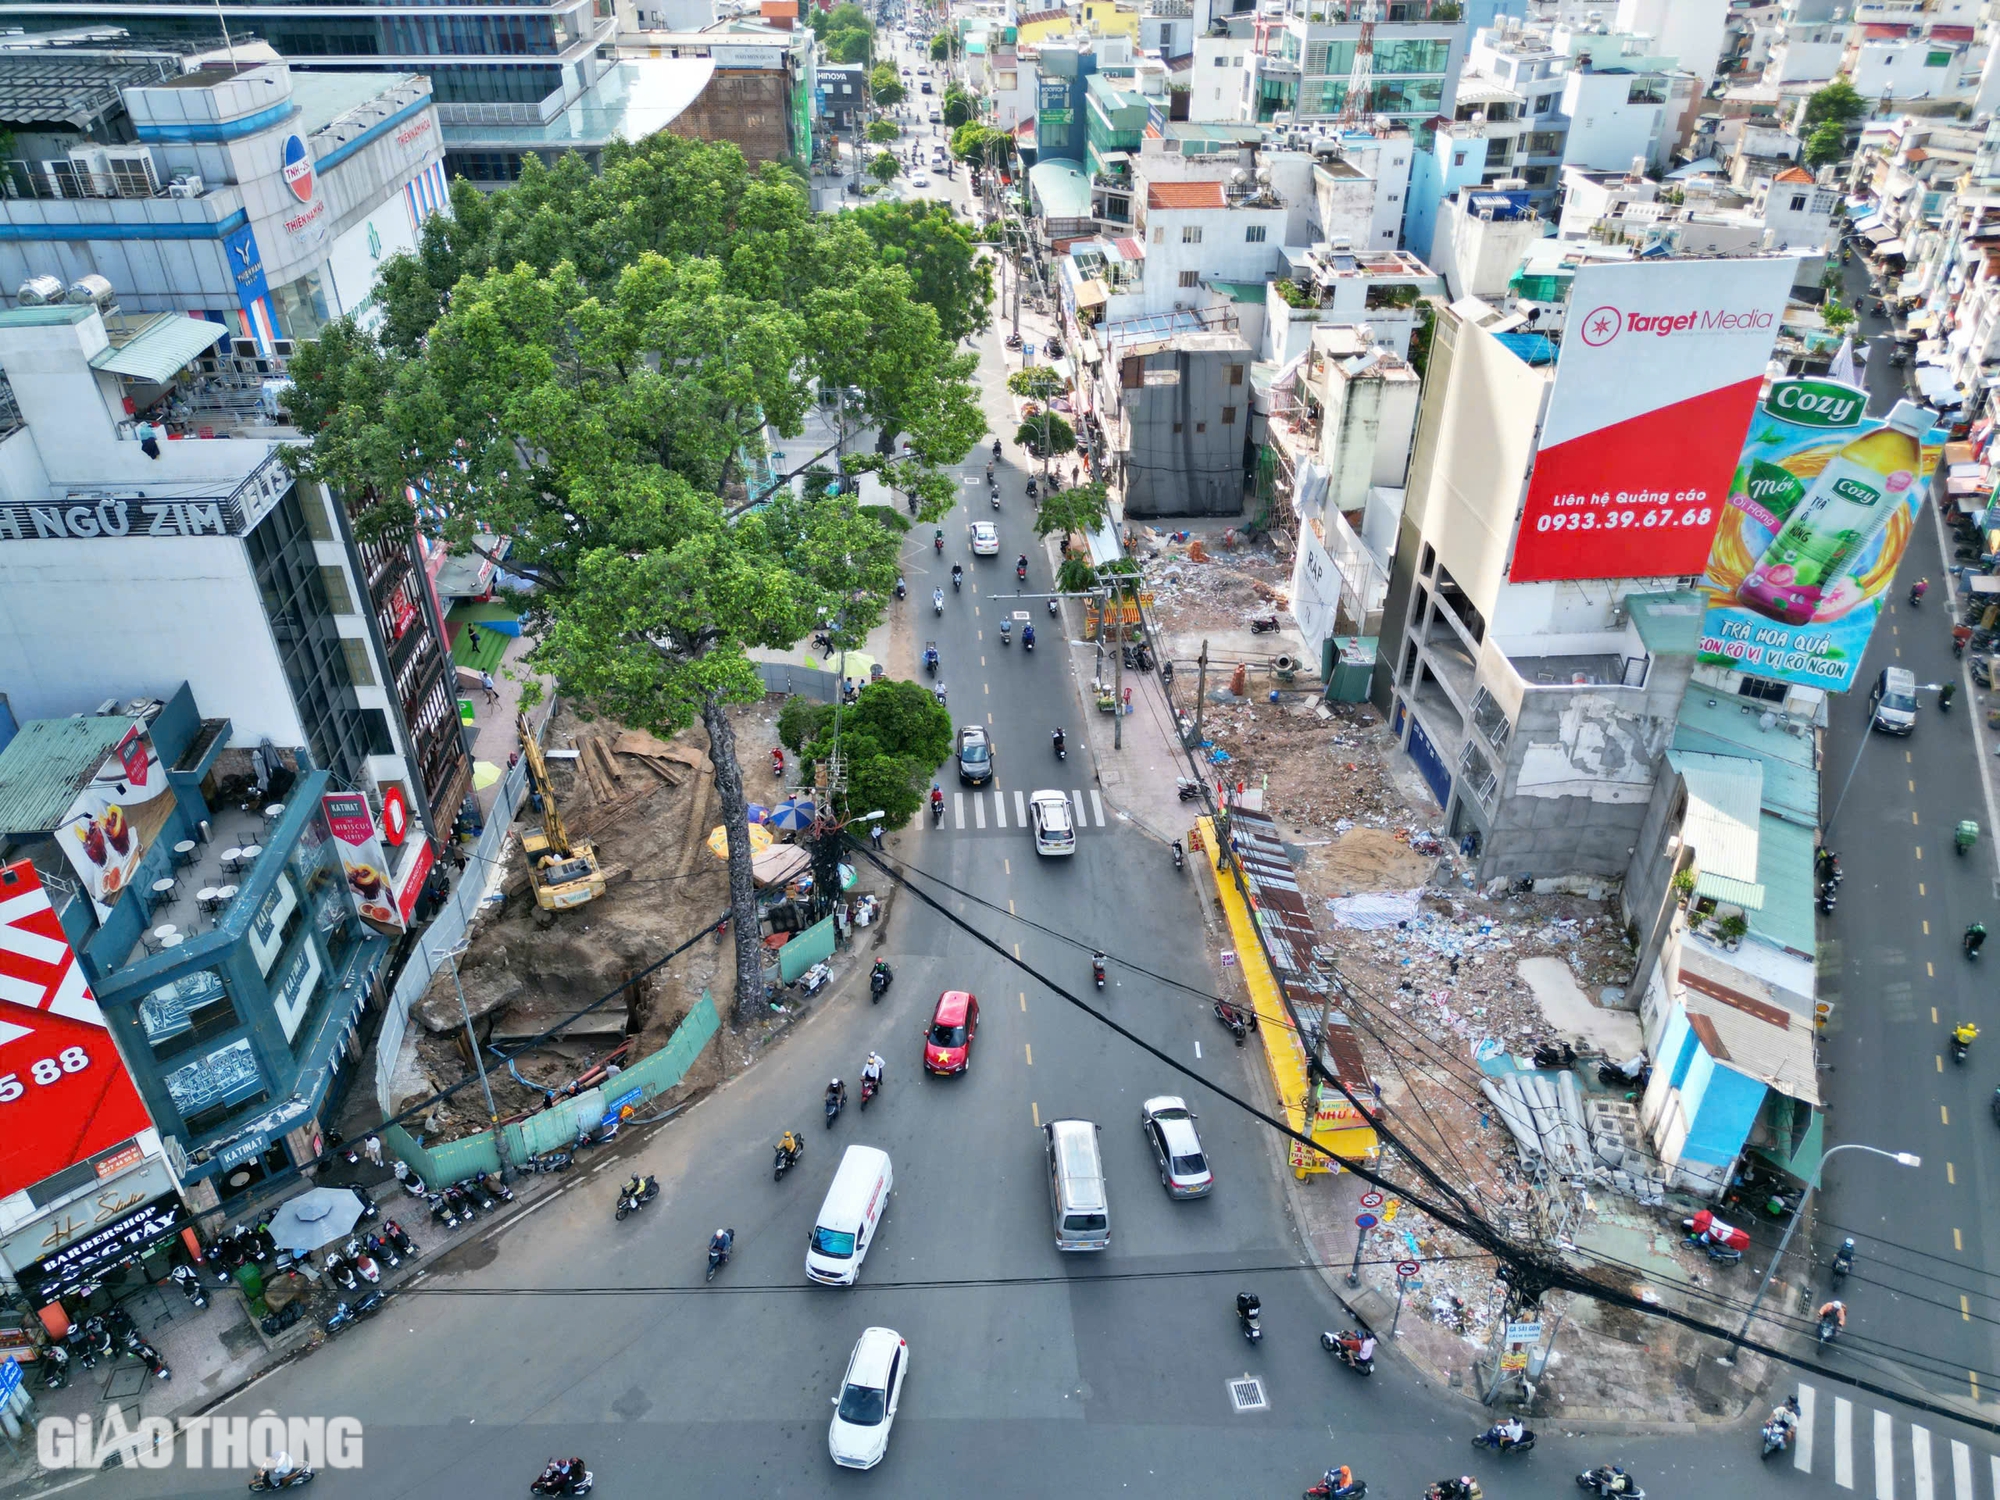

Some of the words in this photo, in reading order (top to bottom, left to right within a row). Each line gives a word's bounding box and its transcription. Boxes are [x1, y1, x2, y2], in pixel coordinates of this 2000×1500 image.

[1626, 310, 1698, 337] Target
[1700, 308, 1773, 330] Media
[1776, 386, 1856, 421] Cozy
[238, 460, 288, 527] IELTS
[1554, 492, 1584, 507] Liên
[1590, 491, 1610, 508] hệ
[1616, 491, 1668, 506] Quảng
[1676, 490, 1706, 502] cáo
[1838, 480, 1876, 504] Cozy
[29, 498, 130, 538] NGỮ
[141, 504, 226, 536] ZIM
[1537, 508, 1712, 532] 0933.39.67.68
[1721, 620, 1754, 640] TRÀ
[1756, 628, 1788, 648] HOA
[1794, 633, 1832, 655] QUẢ
[1725, 642, 1746, 658] RÕ
[1747, 646, 1762, 664] VỊ
[1767, 651, 1782, 669] VỊ
[1785, 652, 1805, 670] RÕ
[1808, 658, 1846, 678] NGON
[331, 804, 358, 812] KATINAT
[30, 1046, 89, 1086] 88
[1316, 1109, 1349, 1120] NHƯ
[224, 1136, 263, 1163] KATINAT
[42, 1206, 156, 1272] BARBERSHOP
[124, 1210, 176, 1244] TÂY
